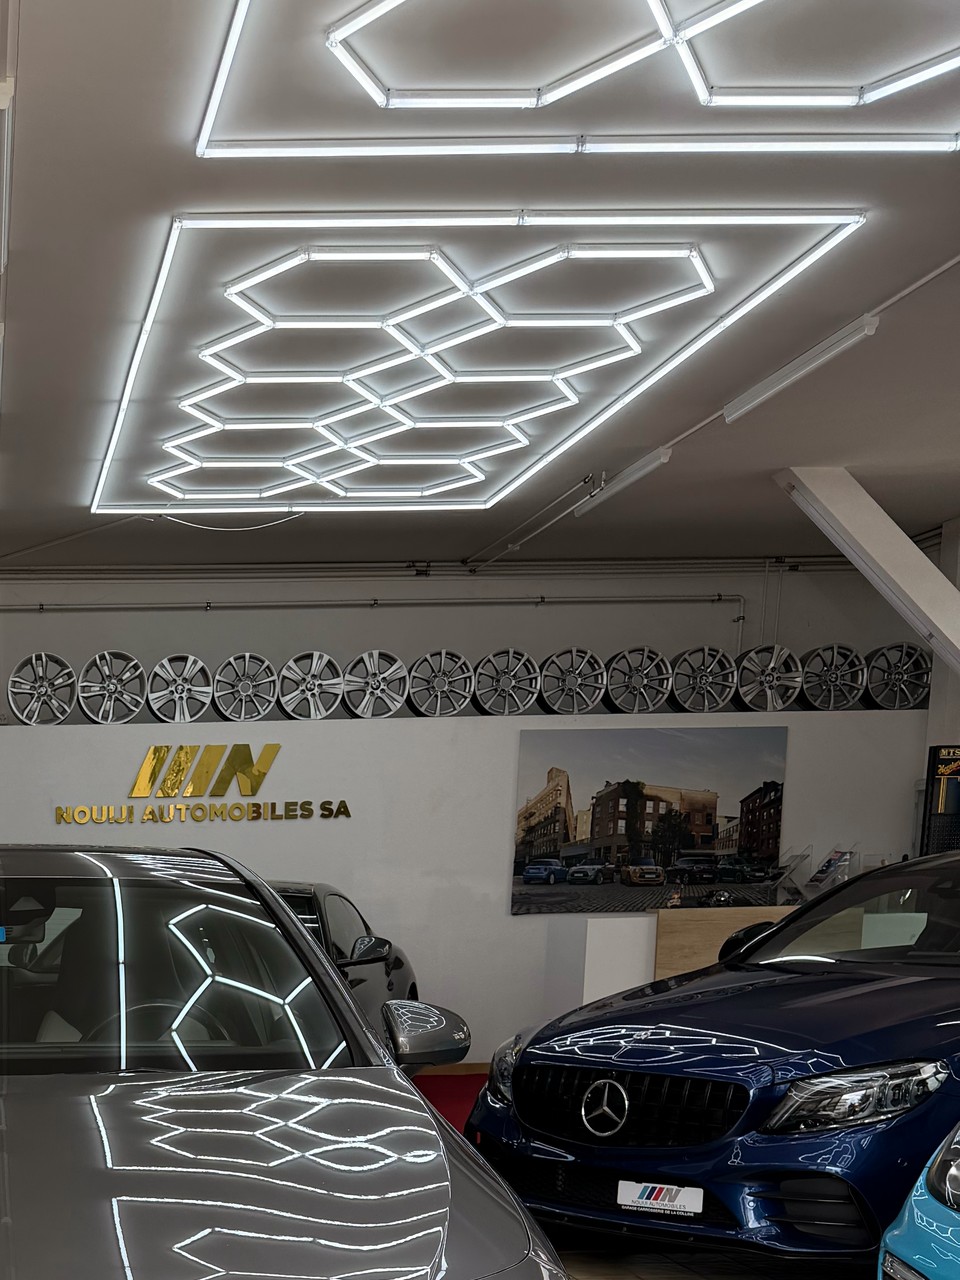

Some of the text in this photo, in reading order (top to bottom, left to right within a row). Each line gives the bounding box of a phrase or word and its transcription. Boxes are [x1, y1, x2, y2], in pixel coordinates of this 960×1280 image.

[55, 799, 352, 825] NOUIJI AUTOMOBILES SA
